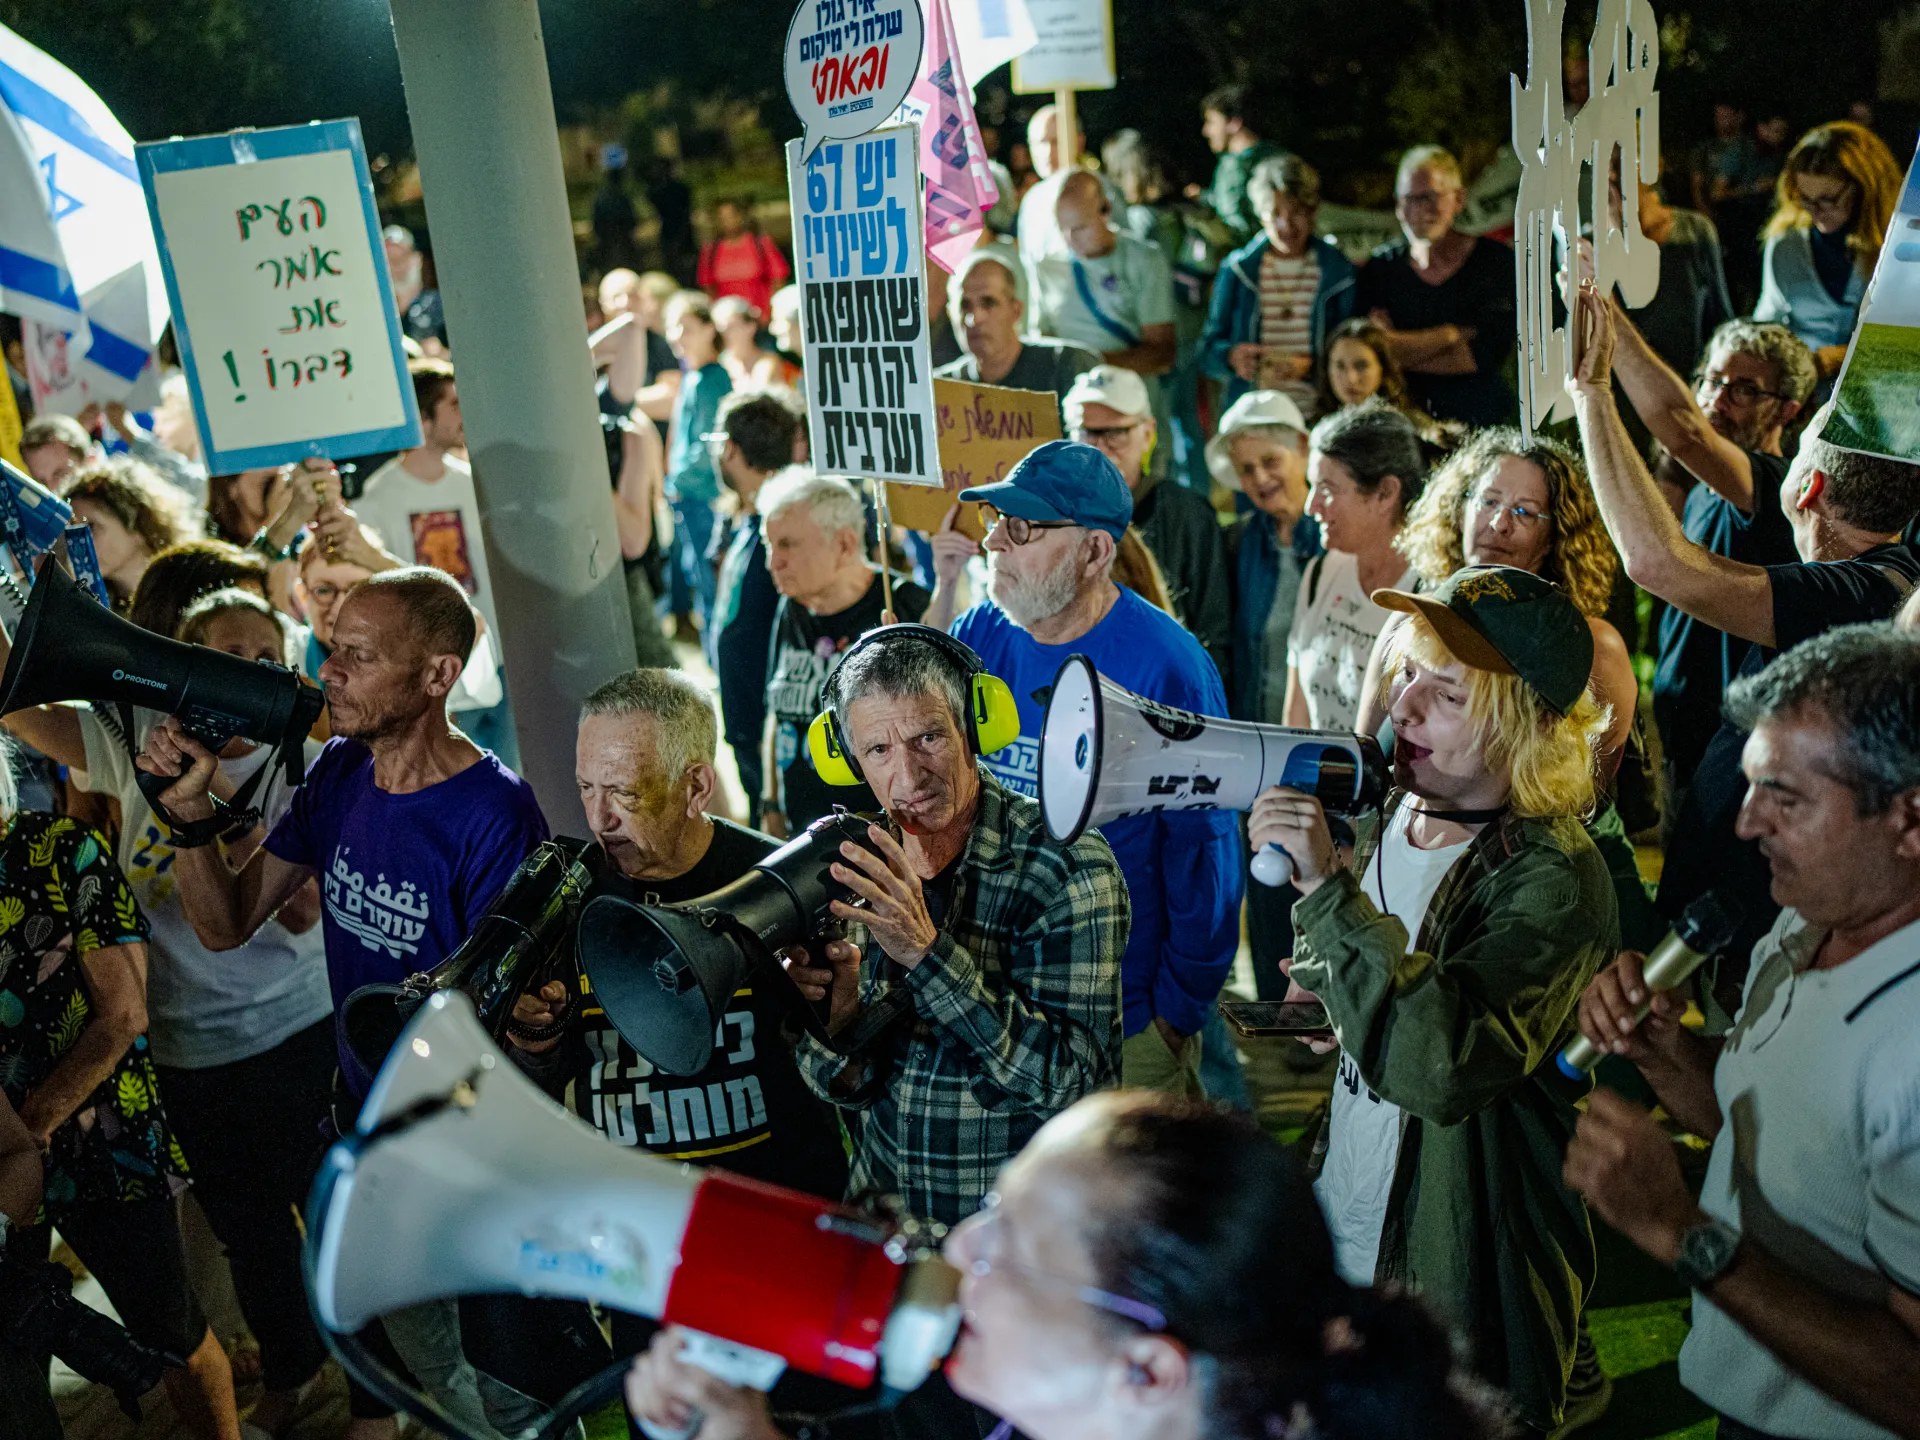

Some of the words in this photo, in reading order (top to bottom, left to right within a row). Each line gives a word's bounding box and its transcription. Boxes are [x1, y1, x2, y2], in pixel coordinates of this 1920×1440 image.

[816, 0, 845, 31] גולן
[845, 20, 860, 47] לי
[863, 9, 902, 44] שלח
[800, 27, 843, 63] מיקום
[812, 43, 889, 105] ובאתי
[807, 144, 843, 213] 67
[855, 138, 896, 208] יש
[236, 196, 326, 242] העם
[803, 197, 909, 279] לשינוי!
[256, 244, 343, 290] אמר
[278, 298, 346, 334] את
[806, 277, 921, 344] שותפות
[818, 346, 918, 409] יהודית
[823, 411, 926, 476] וערבית
[124, 673, 168, 691] PROXTONE
